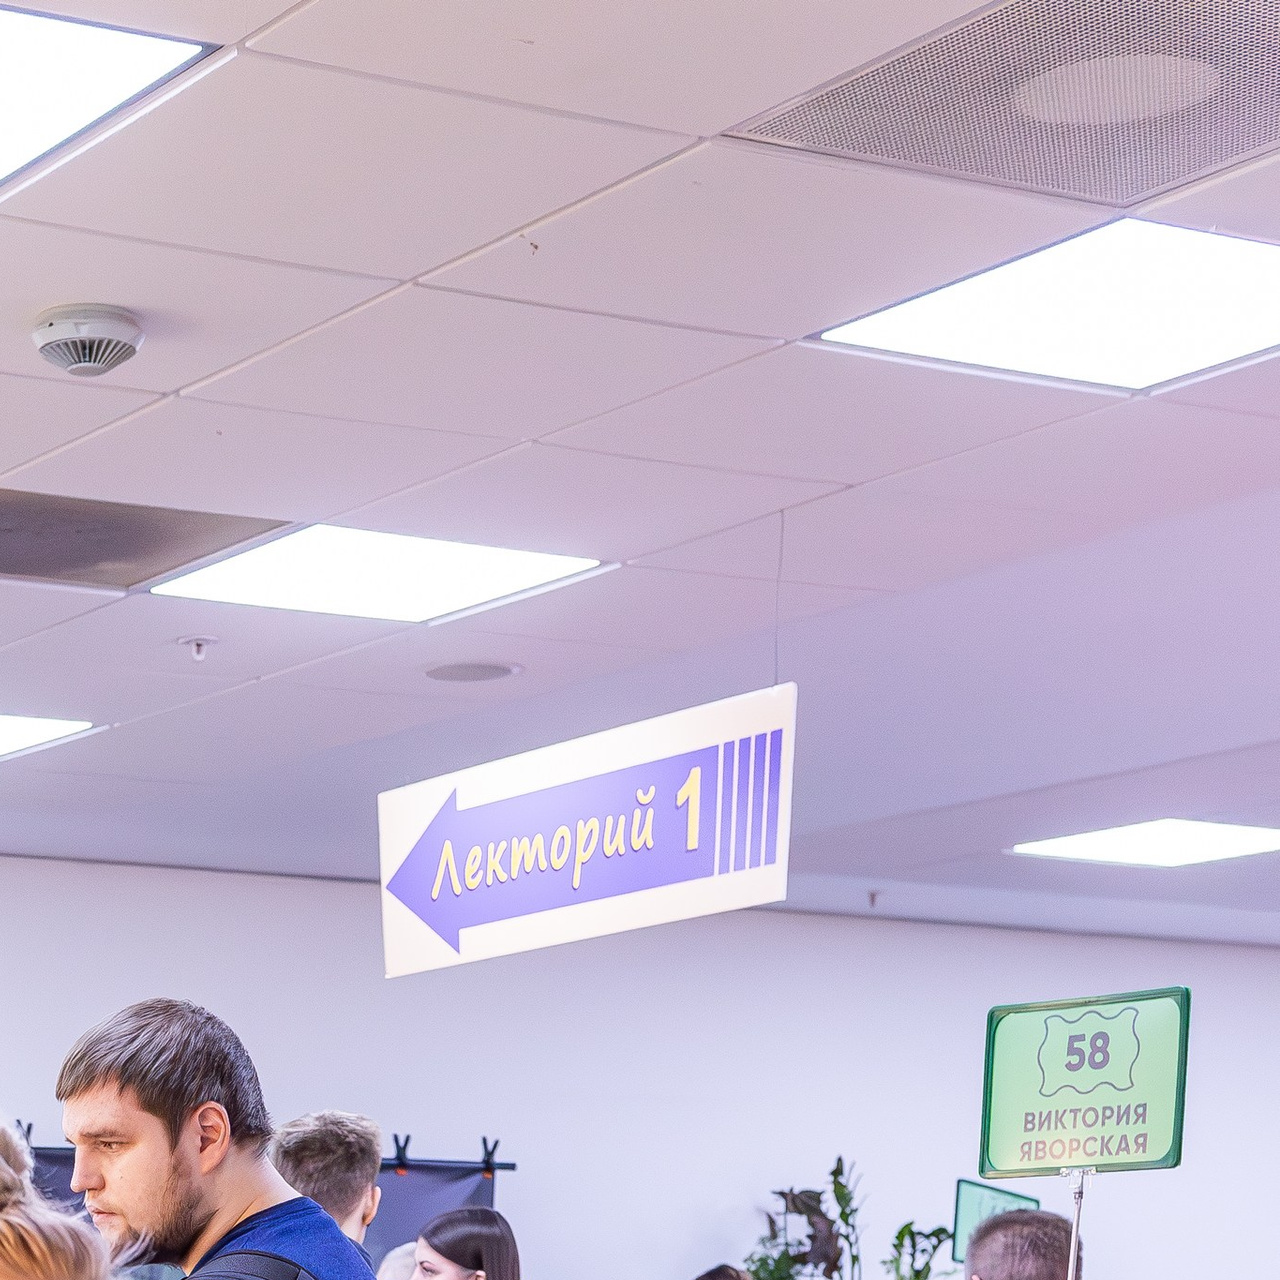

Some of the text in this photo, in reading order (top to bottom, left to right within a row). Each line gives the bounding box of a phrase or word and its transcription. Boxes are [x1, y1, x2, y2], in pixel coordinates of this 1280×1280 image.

[430, 766, 702, 900] Лекторий 1
[1065, 1031, 1110, 1072] 58
[1023, 1102, 1148, 1133] ВИКТОРИЯ
[1019, 1132, 1148, 1162] ЯВОРСКАЯ
